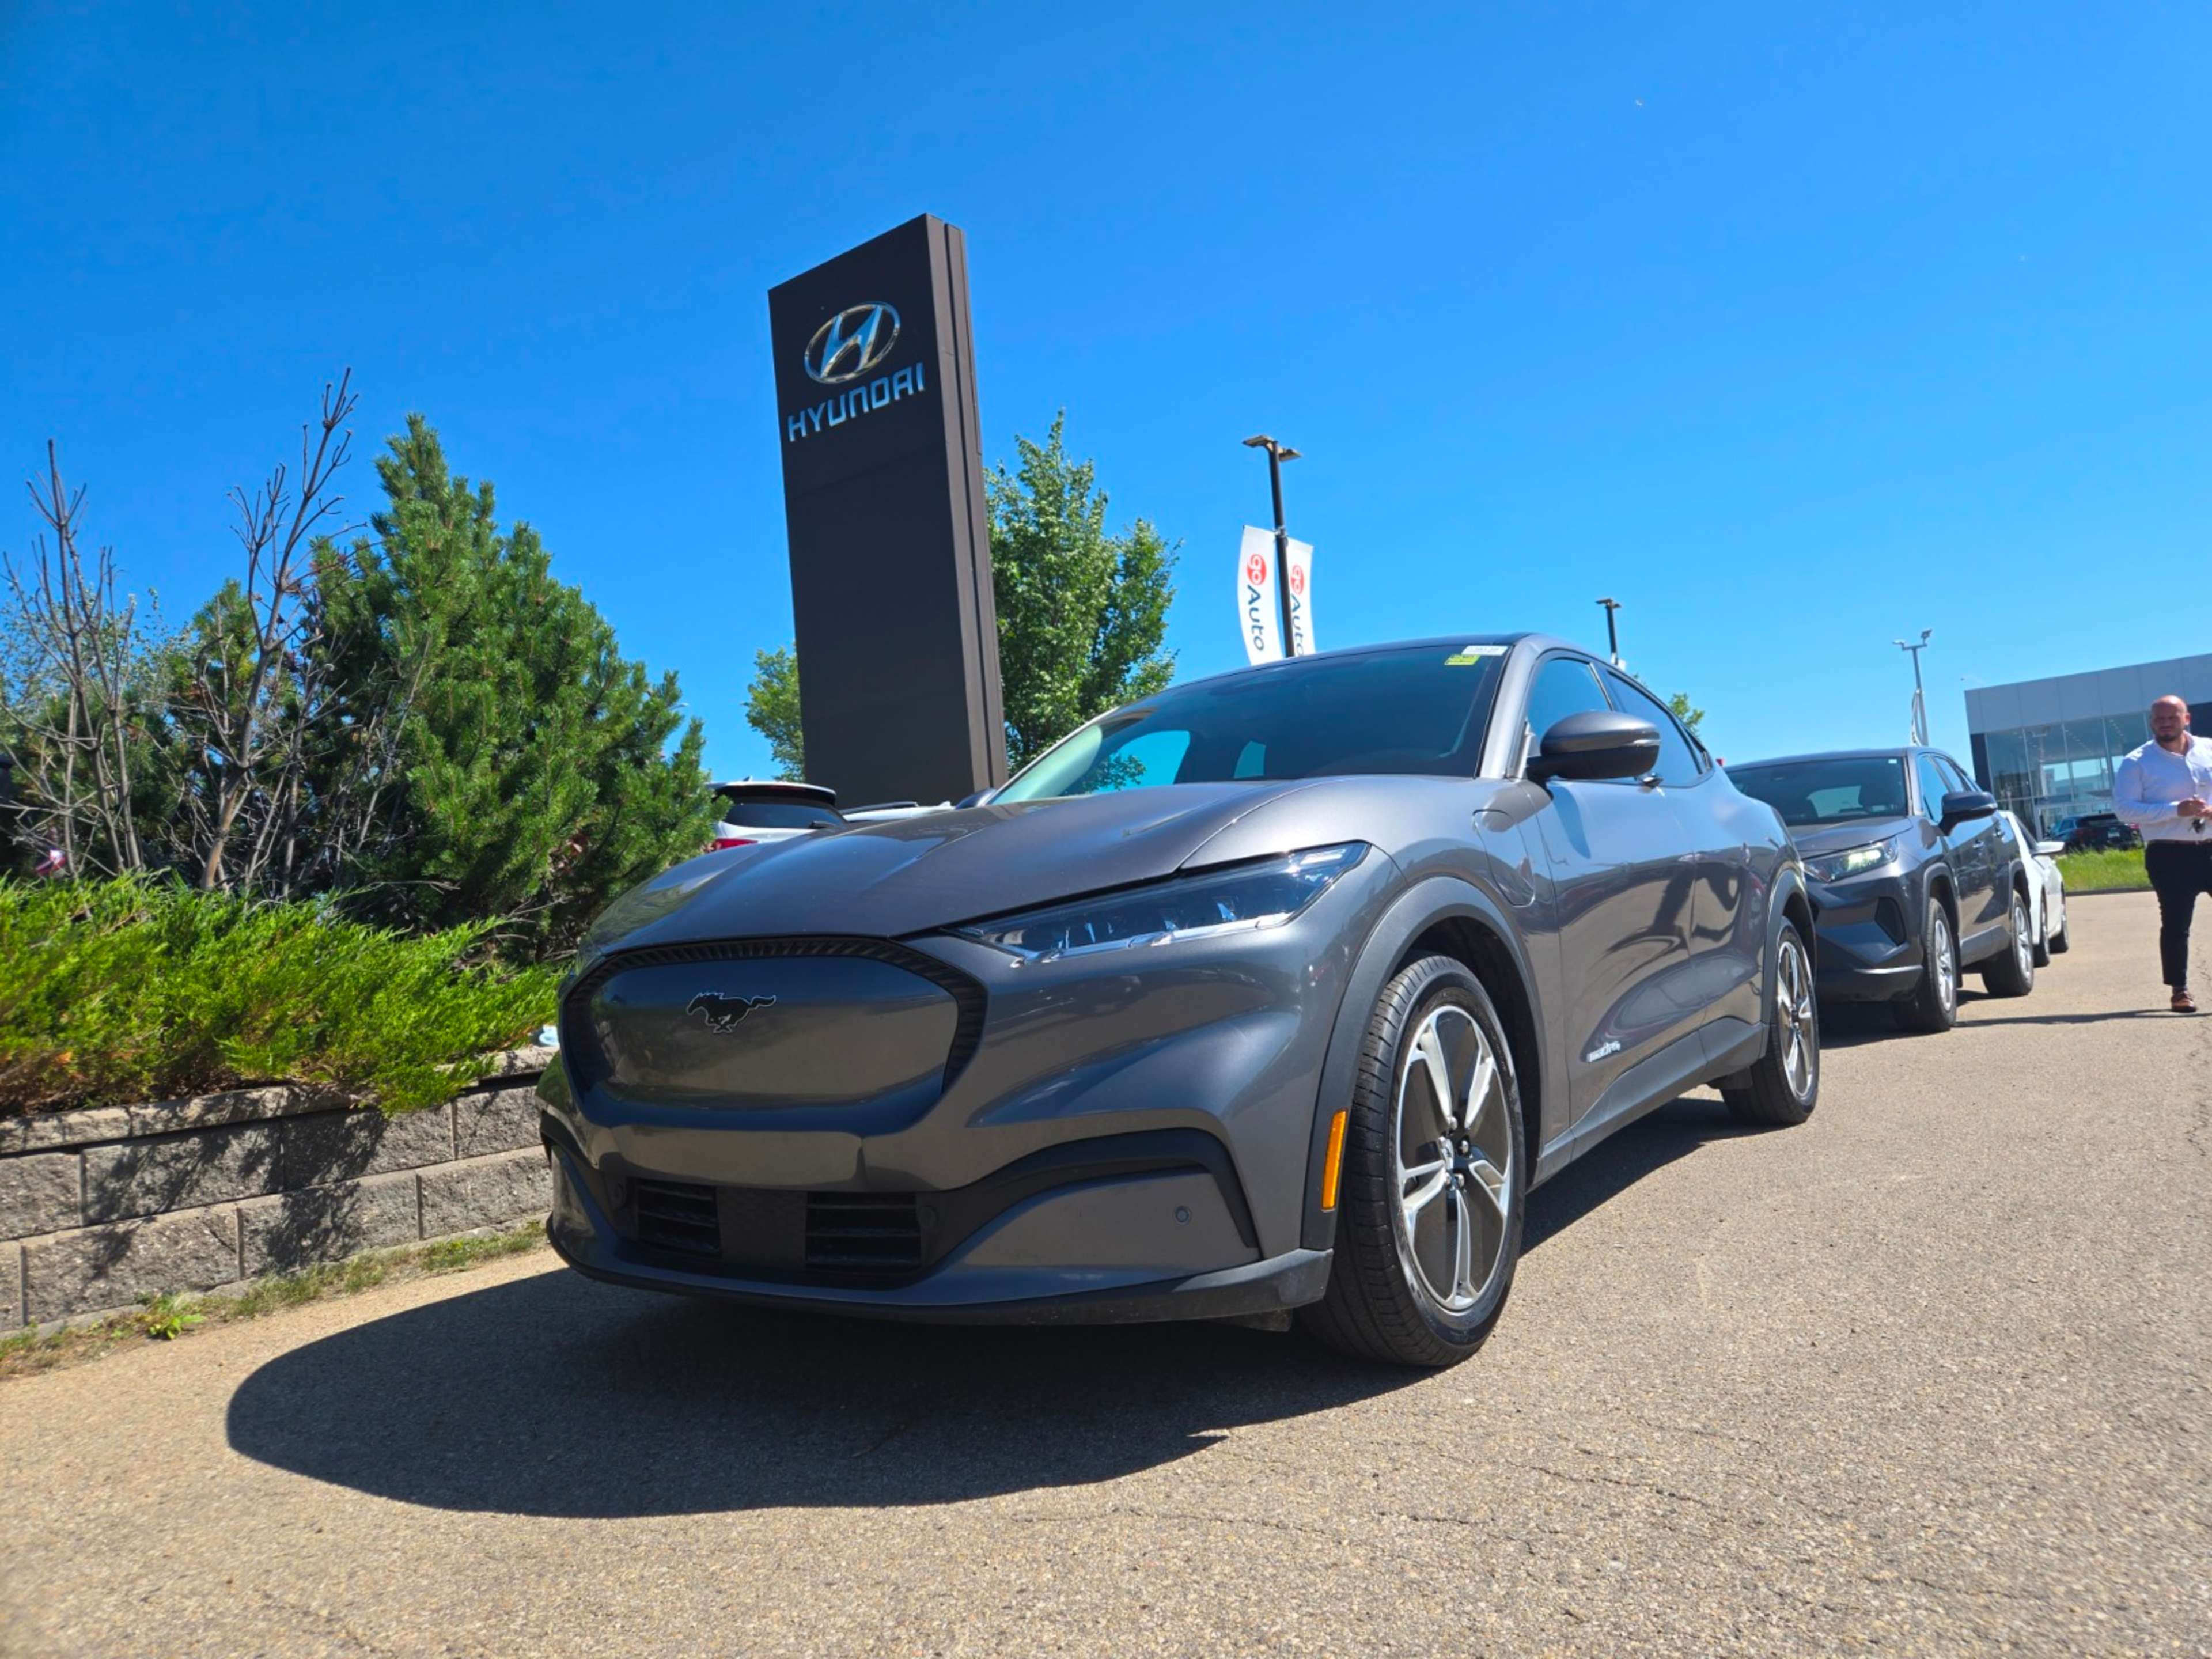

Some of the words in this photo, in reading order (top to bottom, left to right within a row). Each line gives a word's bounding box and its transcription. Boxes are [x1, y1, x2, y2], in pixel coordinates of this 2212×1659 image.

[787, 362, 925, 442] HYUNDAI
[1247, 584, 1264, 652] Auto
[1291, 594, 1304, 656] Auto
